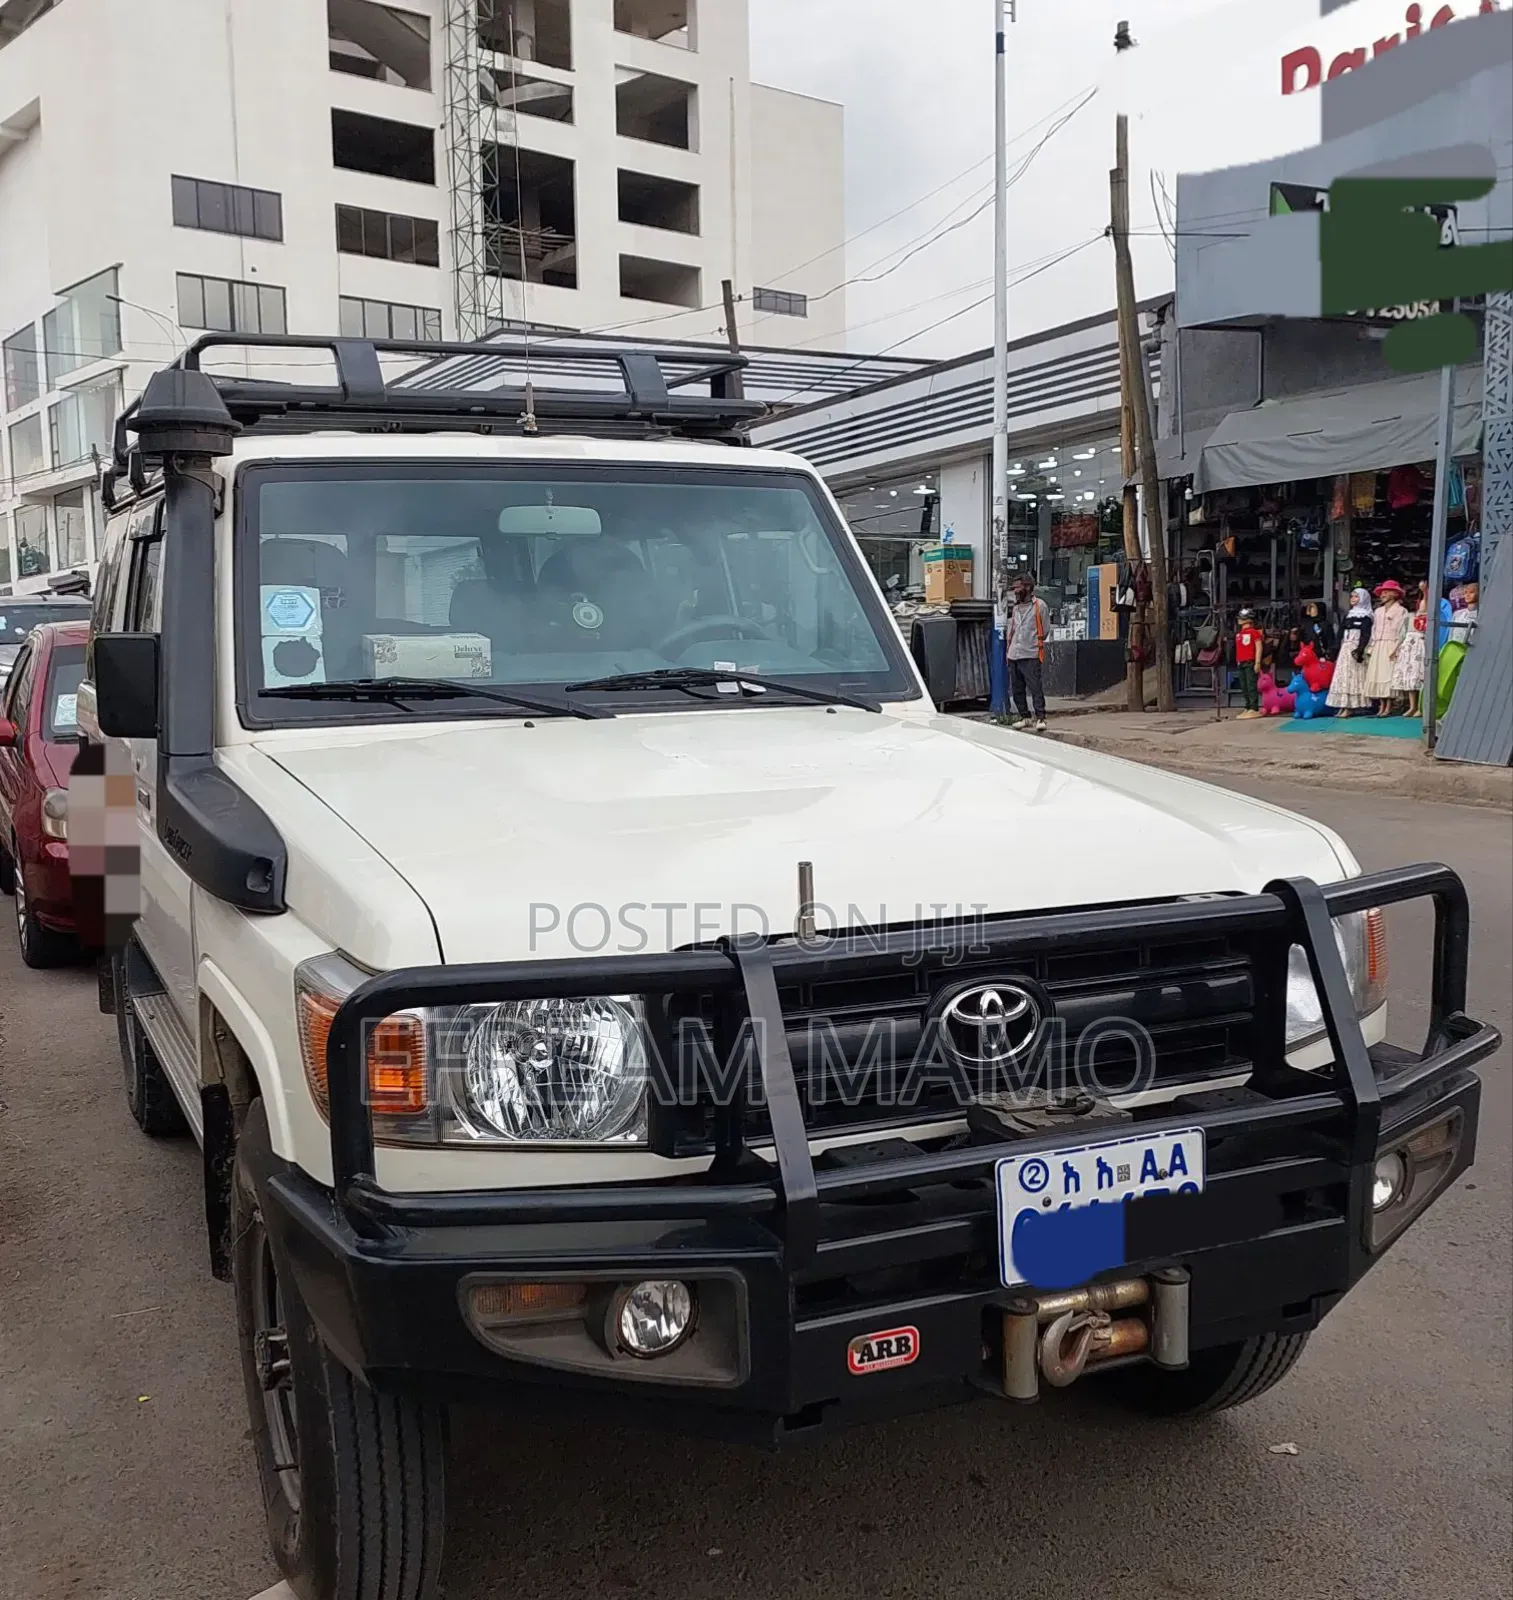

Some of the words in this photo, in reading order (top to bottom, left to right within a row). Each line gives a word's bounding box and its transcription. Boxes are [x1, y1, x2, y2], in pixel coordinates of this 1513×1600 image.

[453, 644, 483, 653] Deluxe
[1139, 1142, 1189, 1184] AA
[857, 1334, 912, 1365] ARB
